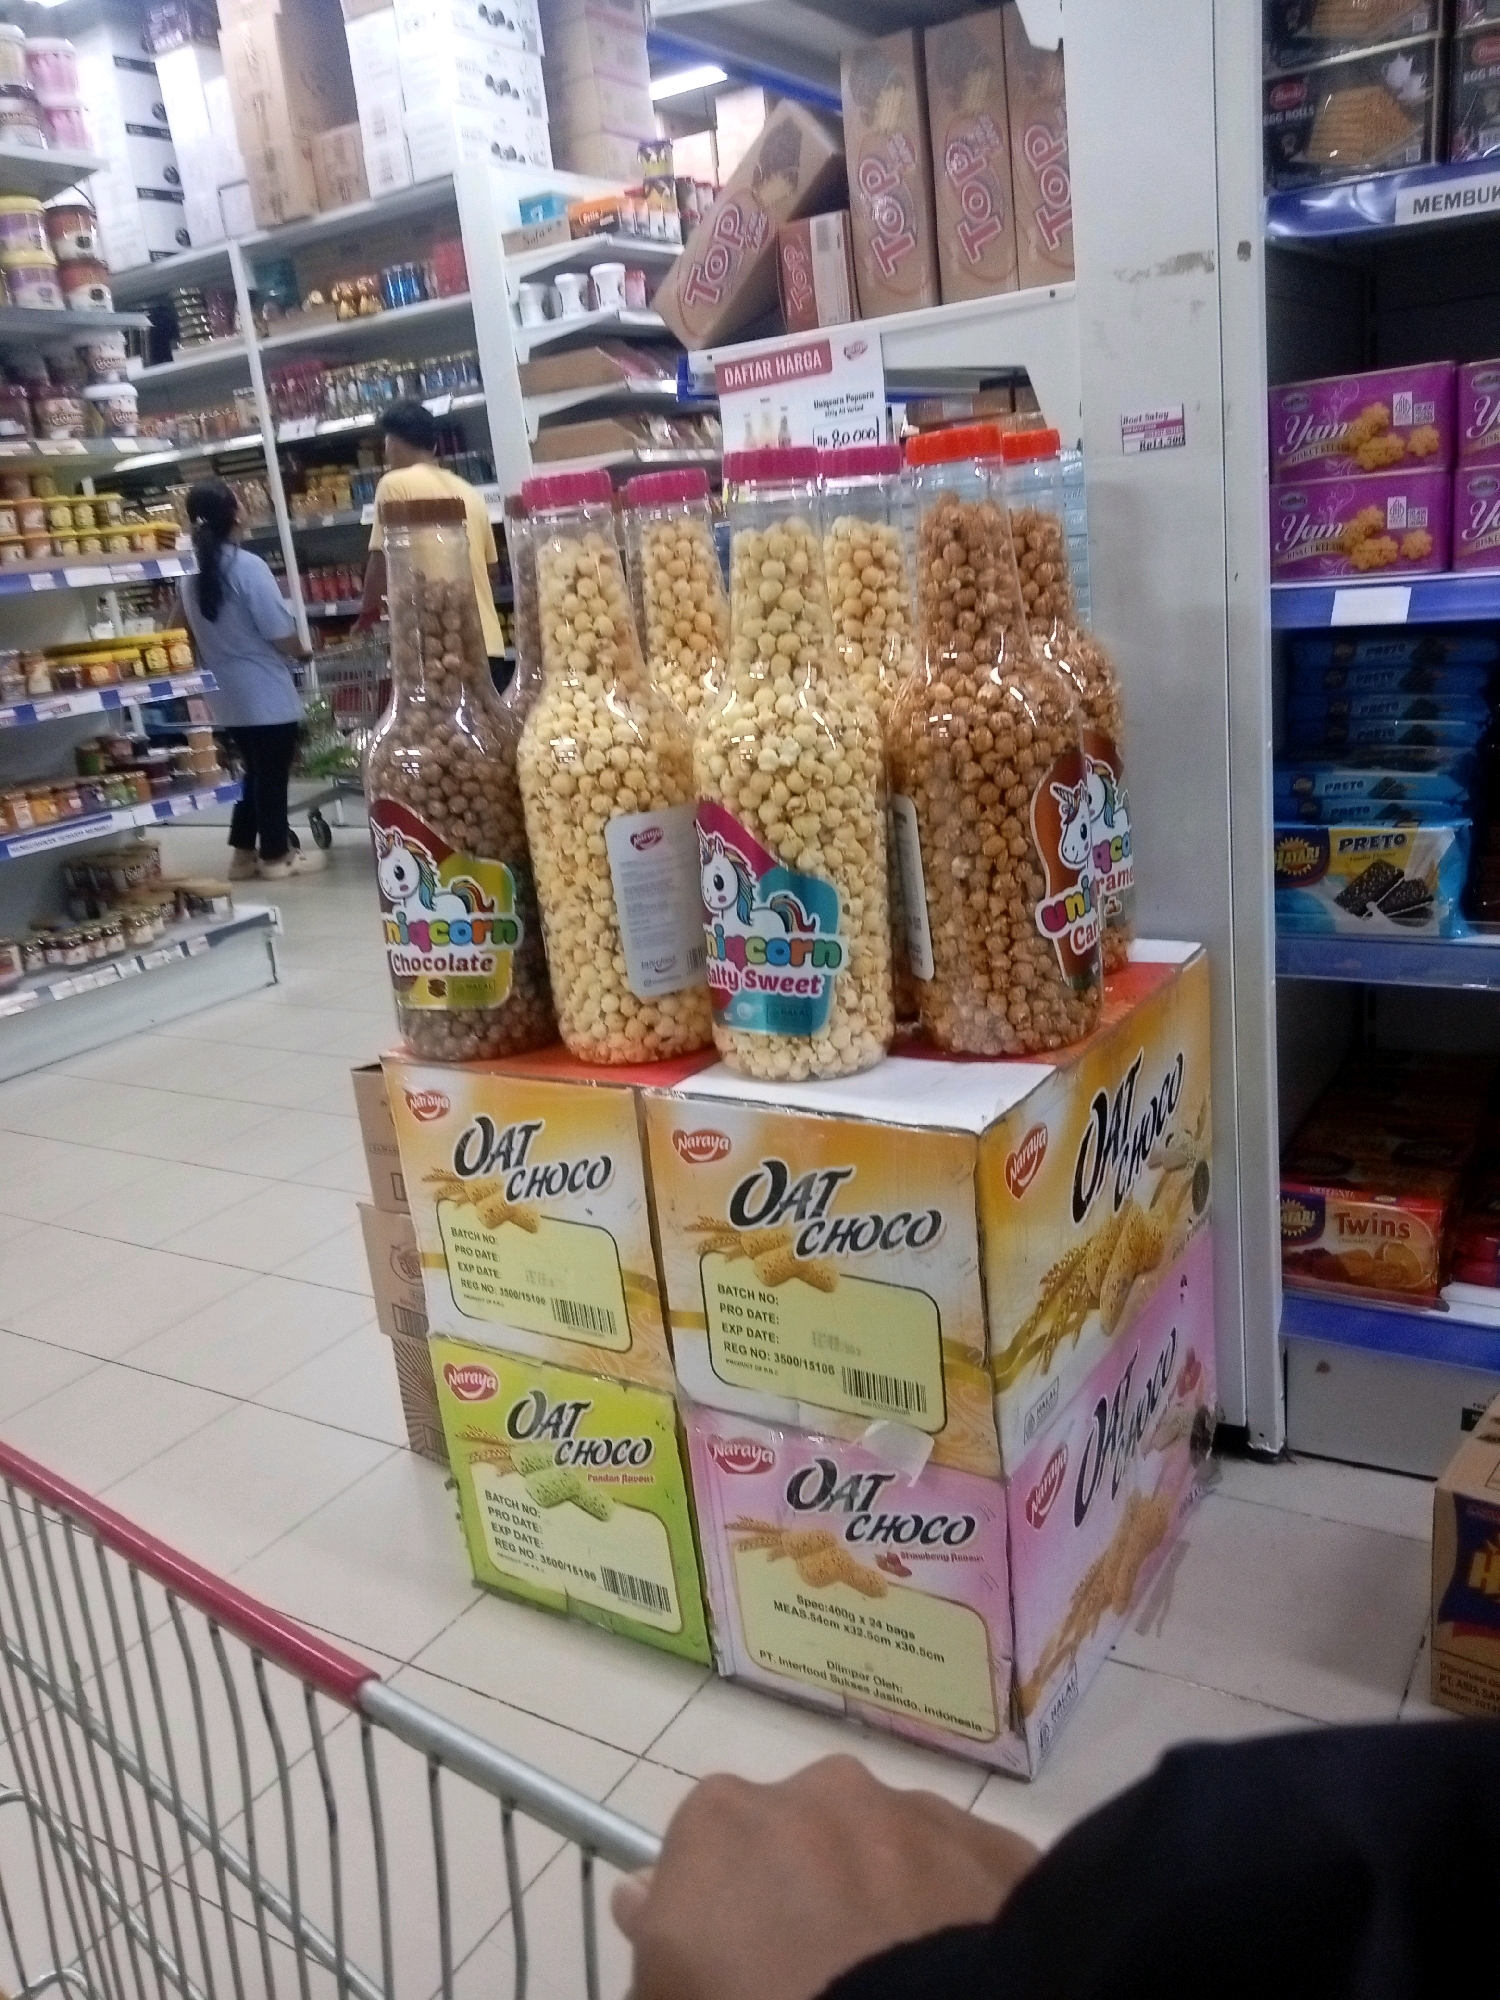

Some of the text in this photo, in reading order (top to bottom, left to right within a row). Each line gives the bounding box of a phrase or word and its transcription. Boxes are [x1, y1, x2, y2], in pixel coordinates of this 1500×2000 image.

[946, 140, 1001, 264] TOP
[859, 157, 916, 279] TOP
[683, 202, 745, 308] TOP
[724, 359, 773, 387] DAFTAR
[775, 349, 822, 377] HARGA
[1278, 414, 1352, 455] Yam
[1275, 513, 1349, 552] Yam
[1324, 780, 1366, 792] PRETO
[1330, 805, 1371, 817] PRETO
[1338, 833, 1407, 854] PRETO
[1041, 875, 1097, 932] uni
[392, 953, 493, 973] Chocolate
[744, 970, 822, 995] Sweet
[410, 1092, 450, 1111] Naraya
[454, 1116, 542, 1177] OAT
[676, 1132, 731, 1153] Naraya
[1072, 1048, 1143, 1224] OAT
[1010, 1126, 1047, 1180] Naraya
[506, 1155, 613, 1202] CHOCO
[729, 1160, 852, 1227] OAT
[451, 1226, 480, 1242] BATCH
[795, 1209, 942, 1256] CHOCO
[1334, 1212, 1411, 1239] Twins
[454, 1244, 473, 1257] PRO
[457, 1261, 474, 1272] EXP
[460, 1278, 479, 1291] REG
[717, 1283, 779, 1306] BATCH NO:
[720, 1302, 779, 1325] PRO DATE:
[722, 1322, 779, 1344] EXP DATE:
[724, 1341, 747, 1355] REG
[750, 1346, 770, 1361] NO:
[448, 1369, 499, 1392] Naraya
[507, 1390, 592, 1440] OAT
[554, 1438, 653, 1467] CHOCO
[711, 1441, 776, 1469] Naraya
[787, 1458, 895, 1513] OAT
[1031, 1447, 1068, 1522] Naraya
[485, 1489, 541, 1519] BATCH NO:
[488, 1506, 510, 1522] PRO
[491, 1521, 544, 1550] EXP DATE:
[494, 1536, 516, 1553] REG
[846, 1514, 976, 1546] CHOCO
[796, 1593, 856, 1624] Spec:400g
[868, 1617, 883, 1629] 24
[885, 1622, 916, 1640] bags
[759, 1649, 776, 1664] PT.
[830, 1672, 870, 1694] Sukses
